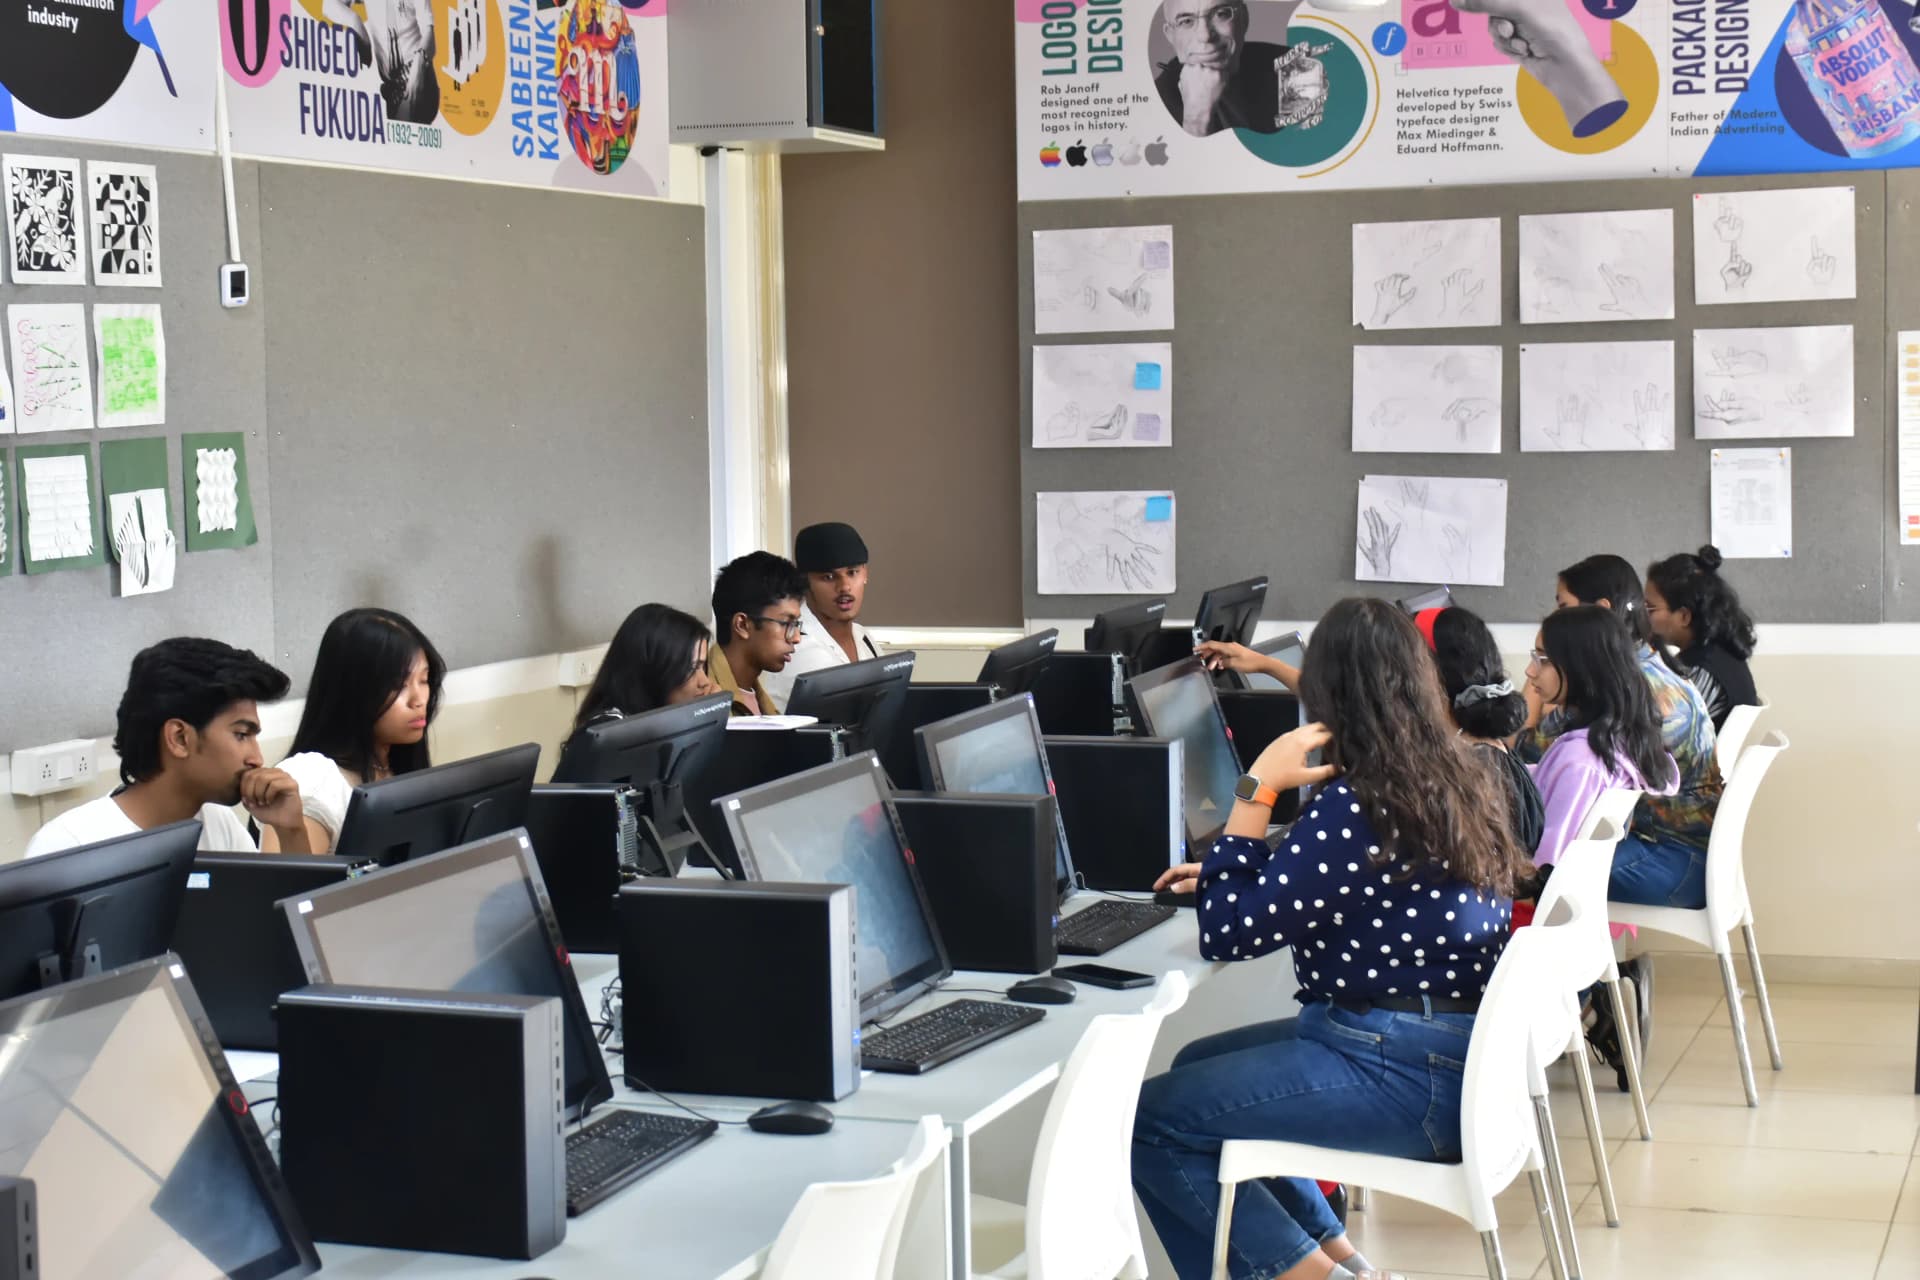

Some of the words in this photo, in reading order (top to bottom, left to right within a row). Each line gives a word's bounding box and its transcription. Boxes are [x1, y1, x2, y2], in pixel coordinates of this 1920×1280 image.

[27, 4, 79, 34] industry
[279, 13, 360, 78] SHIGEO
[1041, 1, 1077, 76] LOGO
[1818, 27, 1886, 76] ABSOLUT
[1832, 46, 1891, 86] VODKA
[535, 15, 560, 161] KARNIK
[1040, 85, 1061, 95] Rob
[1065, 83, 1100, 94] Janoff
[1396, 88, 1450, 99] Helvetica
[1453, 85, 1504, 97] typeface
[1040, 96, 1090, 108] designed
[1093, 97, 1113, 105] one
[1116, 94, 1128, 104] of
[1132, 93, 1149, 103] the
[1396, 101, 1457, 113] developed
[1460, 100, 1475, 111] by
[1479, 98, 1513, 109] Swiss
[299, 82, 386, 144] FUKUDA
[1041, 111, 1067, 120] most
[1070, 106, 1130, 119] recognized
[1670, 111, 1708, 122] Father
[1712, 110, 1725, 120] of
[1730, 109, 1777, 120] Modern
[1041, 123, 1071, 134] logos
[1074, 121, 1085, 131] in
[1088, 120, 1128, 132] history.
[1396, 115, 1446, 128] typeface
[1449, 114, 1500, 125] designer
[1397, 130, 1422, 140] Max
[1426, 128, 1485, 139] Miedinger
[1488, 127, 1497, 137] &
[1670, 125, 1709, 136] Indian
[1714, 123, 1785, 135] Advertising
[1397, 143, 1437, 154] Eduard
[1441, 141, 1504, 152] Hoffmann.
